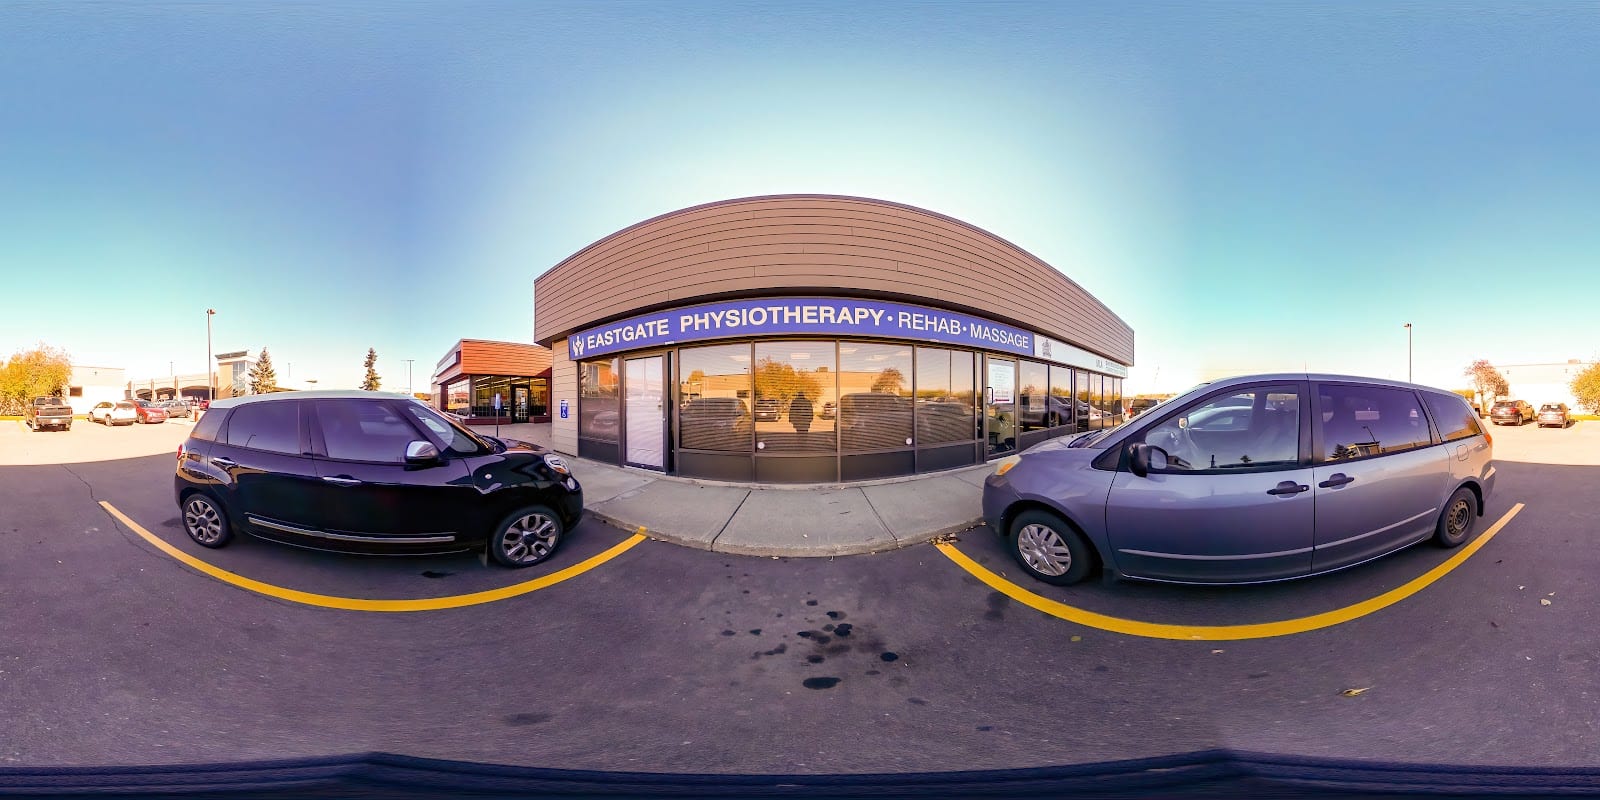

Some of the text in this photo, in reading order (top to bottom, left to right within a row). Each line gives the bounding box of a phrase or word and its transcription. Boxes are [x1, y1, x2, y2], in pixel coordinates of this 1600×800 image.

[588, 306, 1029, 349] EASTGATE PHYSIOTHERAPY REHAB MASSAGE
